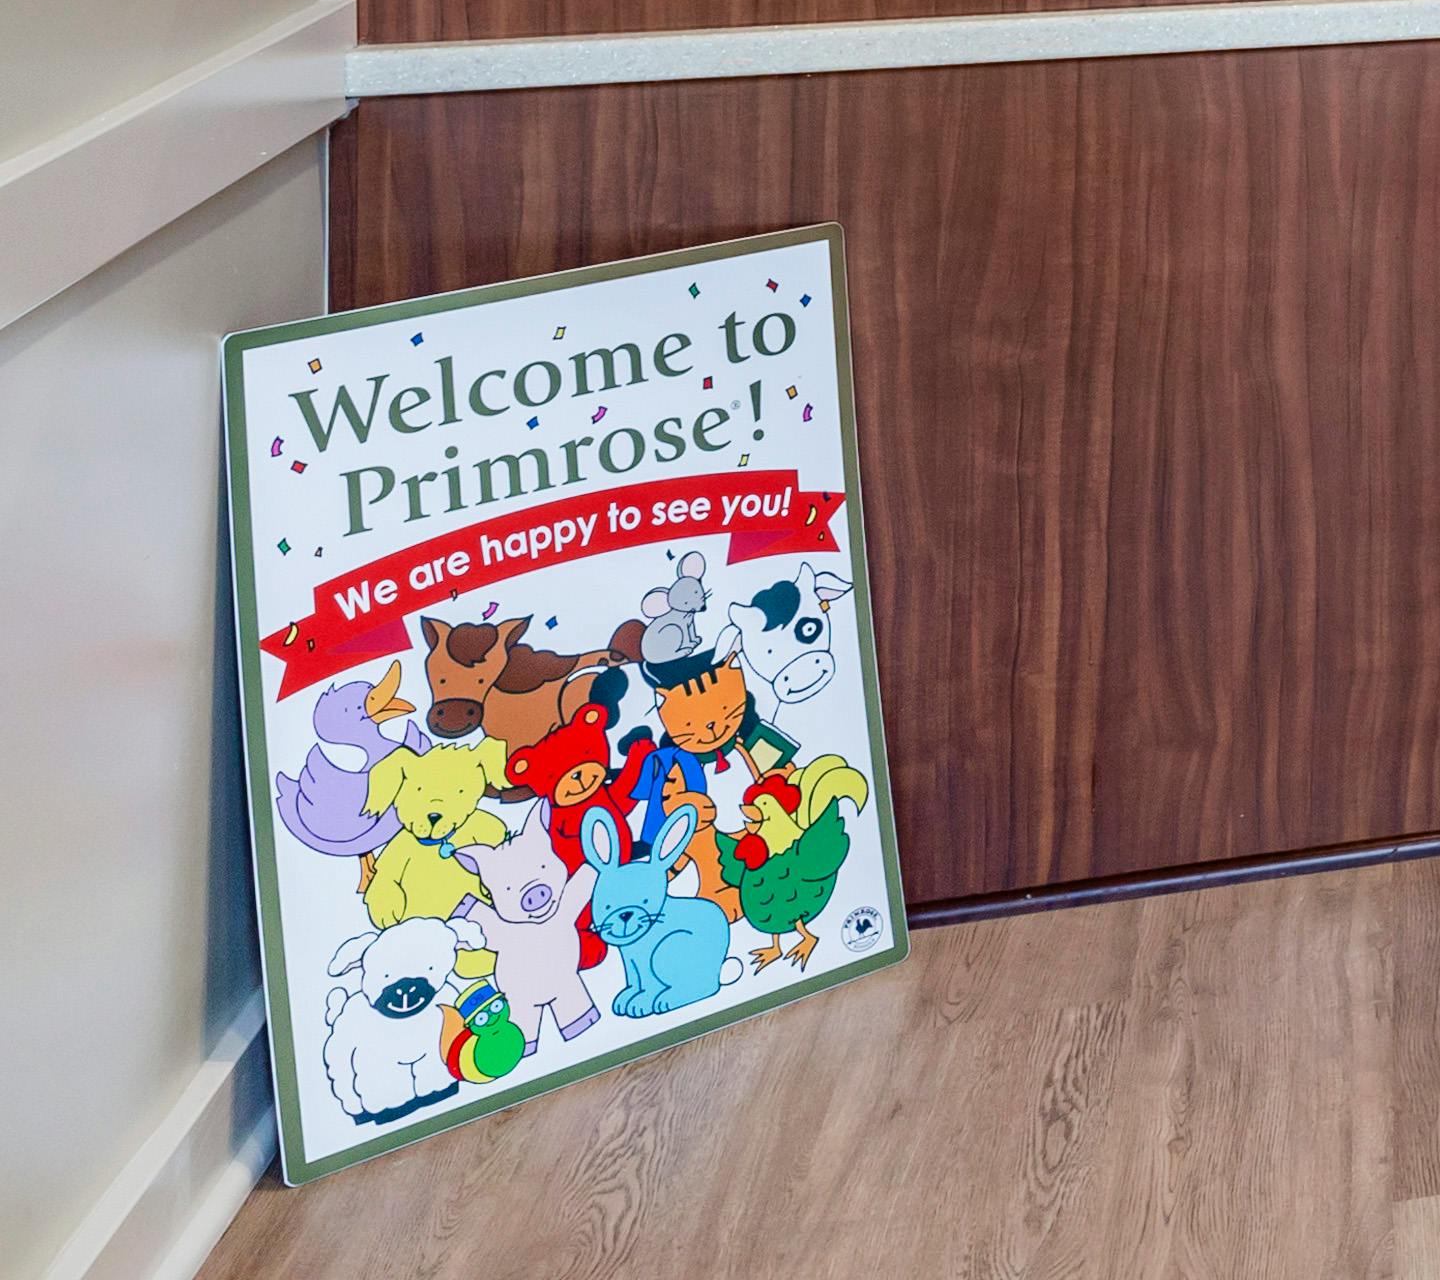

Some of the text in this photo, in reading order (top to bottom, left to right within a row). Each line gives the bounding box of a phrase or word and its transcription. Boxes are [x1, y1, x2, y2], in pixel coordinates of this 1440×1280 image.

[289, 309, 796, 454] Welcome to
[334, 486, 793, 621] We are happy to see you!
